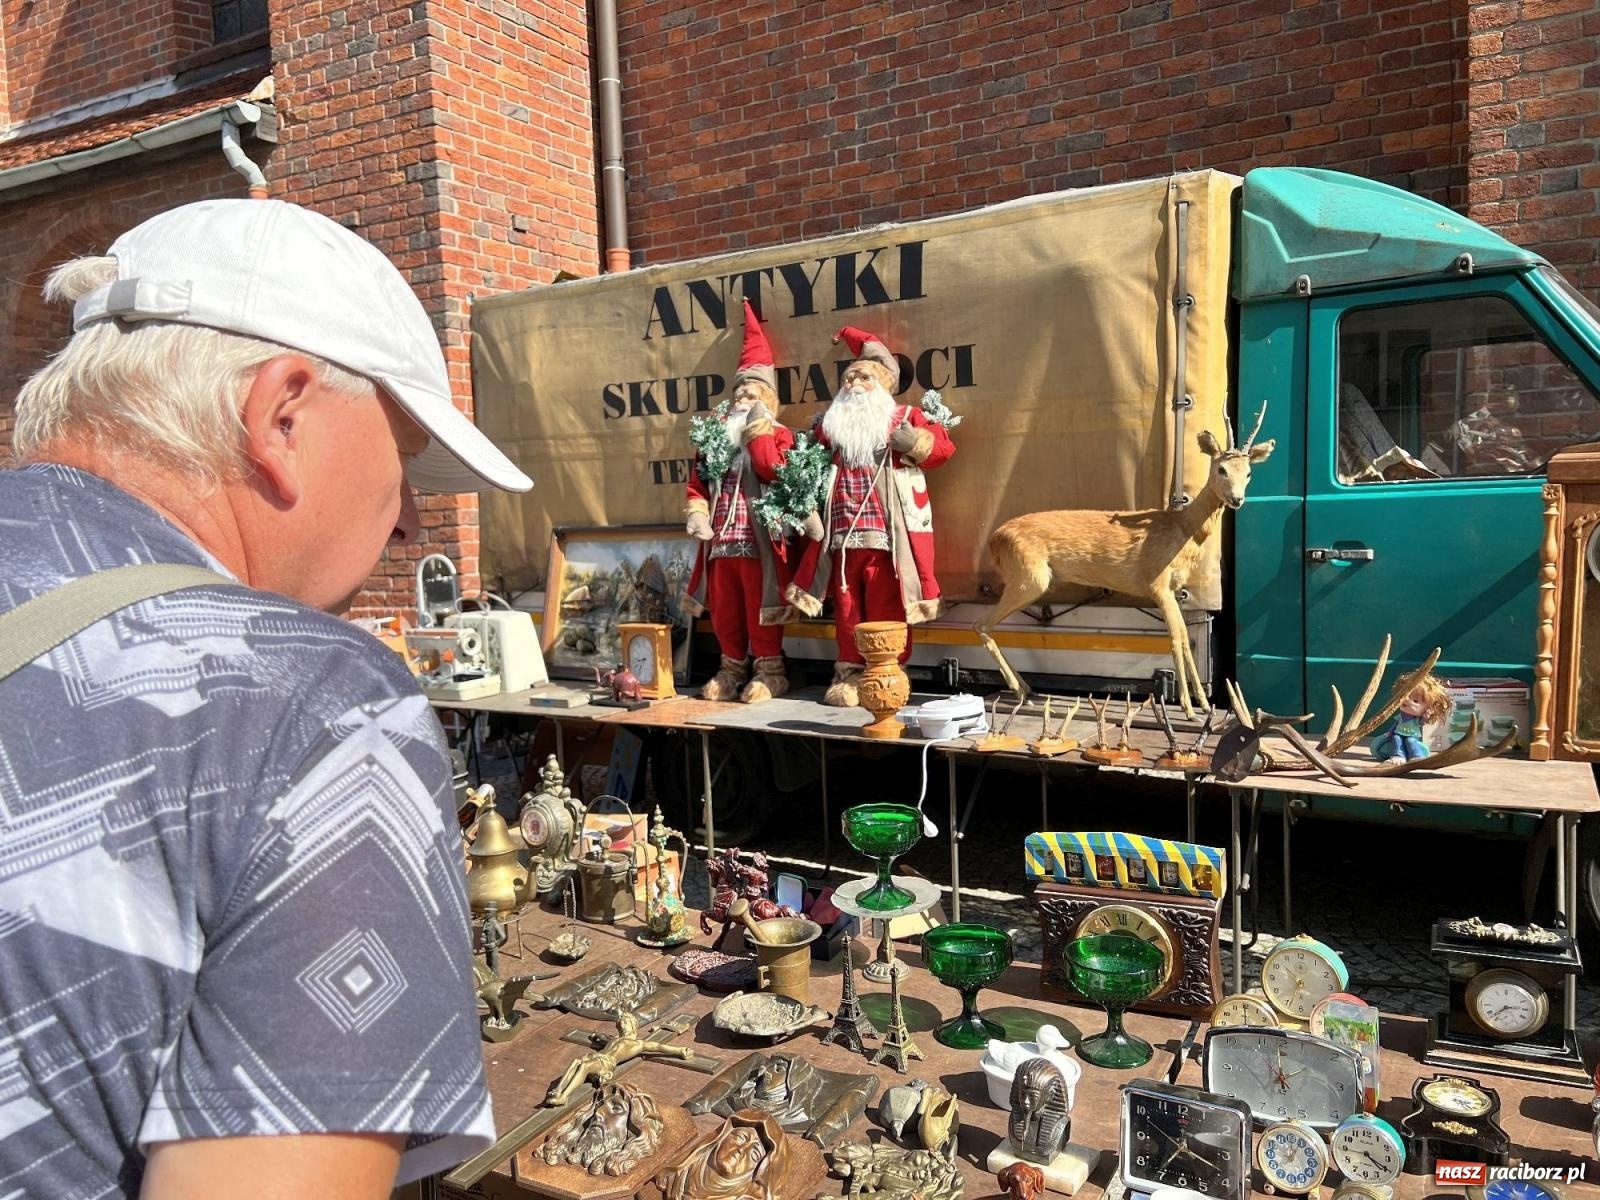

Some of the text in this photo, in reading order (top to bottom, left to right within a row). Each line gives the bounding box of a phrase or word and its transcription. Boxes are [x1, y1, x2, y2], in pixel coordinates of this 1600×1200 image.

[643, 239, 928, 340] ANTYKI
[602, 343, 978, 419] SKUP TAOCI
[648, 458, 696, 485] TE
[1323, 971, 1329, 979] 2
[1226, 1035, 1237, 1046] 10
[1329, 1052, 1340, 1062] 2
[1336, 1081, 1345, 1092] 3
[1136, 1104, 1146, 1115] 10
[1158, 1100, 1167, 1112] 11
[1177, 1104, 1189, 1116] 12
[1258, 1101, 1267, 1111] 7
[1277, 1106, 1288, 1116] 6
[1297, 1109, 1308, 1119] 5
[1329, 1110, 1339, 1120] 4
[1136, 1130, 1146, 1141] 9
[1221, 1124, 1232, 1137] 2
[1352, 1129, 1359, 1138] 11
[1362, 1129, 1372, 1138] 12
[1344, 1135, 1353, 1143] 10
[1383, 1144, 1390, 1152] 2
[1136, 1155, 1146, 1166] 8
[1221, 1150, 1231, 1161] 3
[1344, 1155, 1351, 1164] 8
[1385, 1155, 1391, 1163] 3
[1352, 1165, 1358, 1173] 7
[1362, 1170, 1369, 1178] 6
[1156, 1170, 1166, 1181] 7
[1177, 1176, 1188, 1187] 6
[1198, 1181, 1208, 1192] 5
[1221, 1178, 1230, 1188] 4
